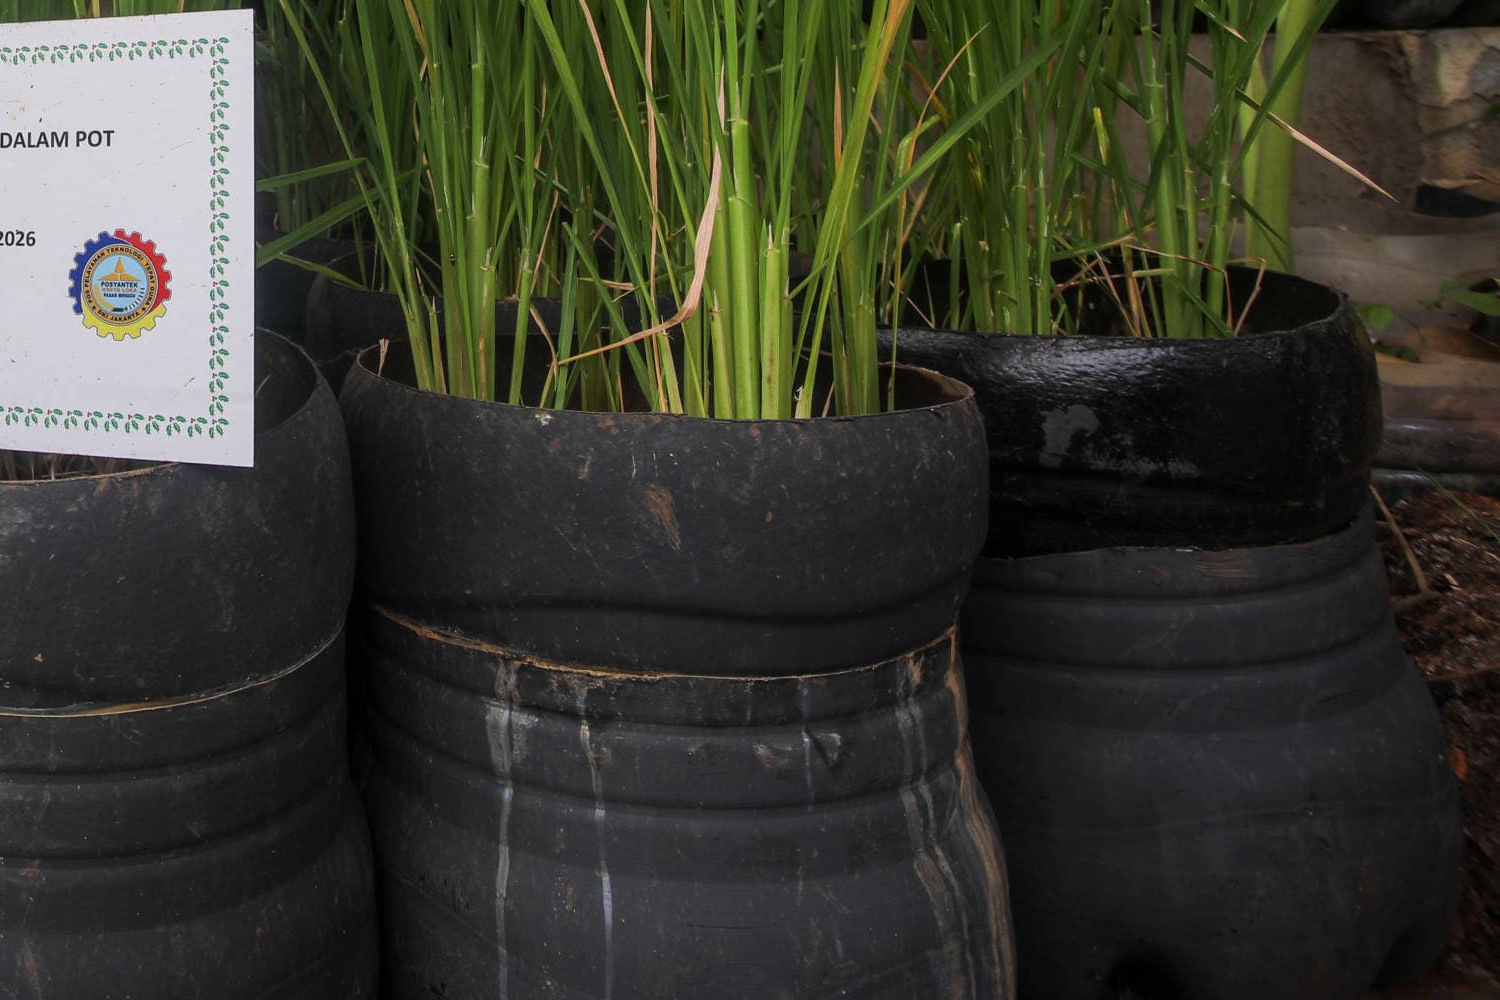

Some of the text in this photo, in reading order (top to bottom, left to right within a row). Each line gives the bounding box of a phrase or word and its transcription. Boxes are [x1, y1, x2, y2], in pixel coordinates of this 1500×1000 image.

[0, 130, 69, 149] DALAM
[75, 130, 115, 148] POT
[84, 252, 106, 288] PELAYANAN
[106, 247, 145, 261] TEKNOLOGI
[109, 311, 140, 321] JAKARTA
